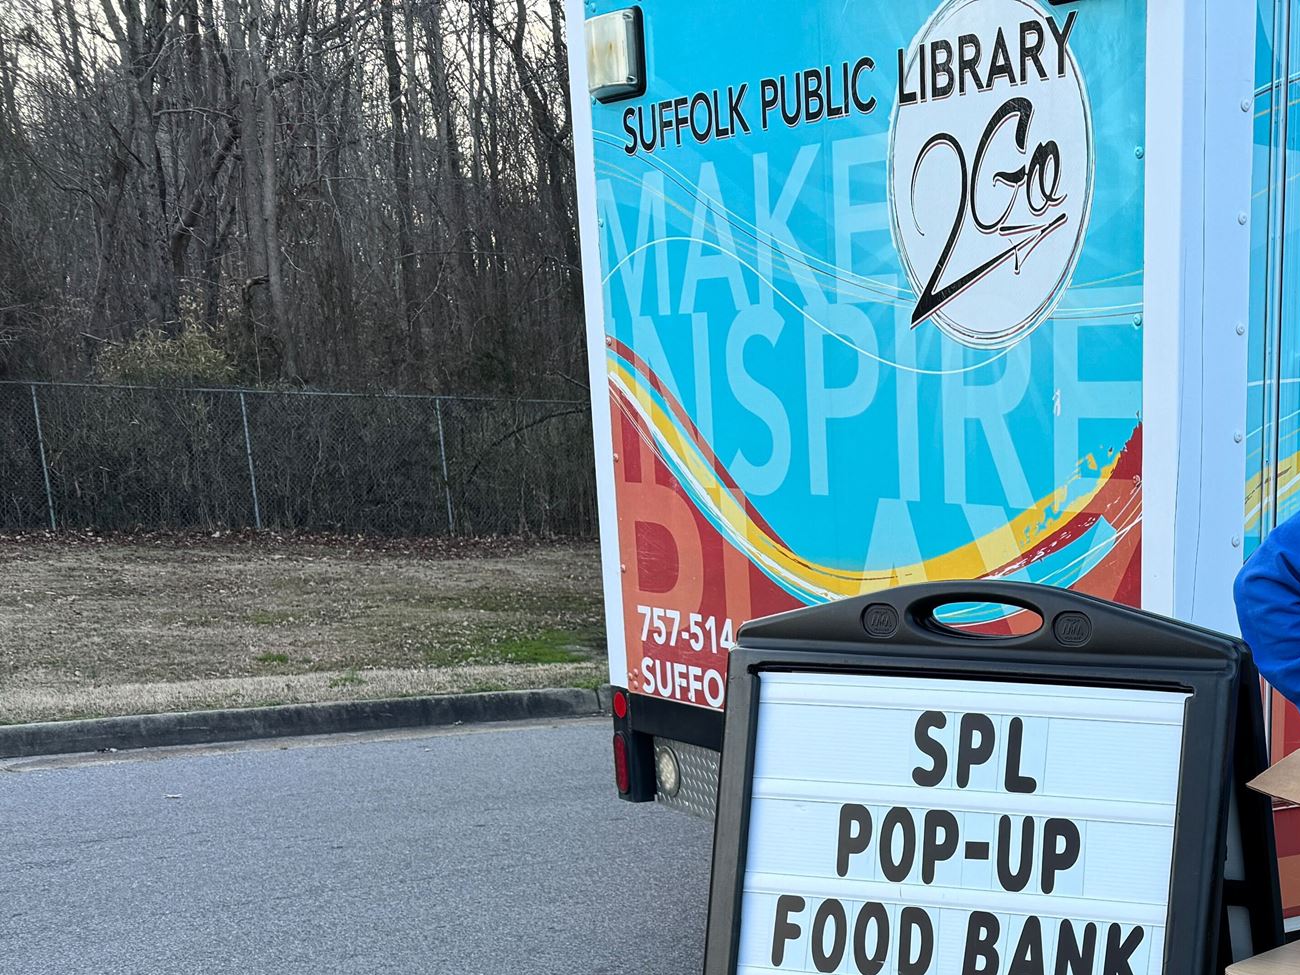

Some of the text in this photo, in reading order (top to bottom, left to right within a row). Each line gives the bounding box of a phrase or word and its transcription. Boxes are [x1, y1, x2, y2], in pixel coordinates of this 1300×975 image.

[622, 10, 1079, 157] SUFFOLK PUBLIC LIBRARY
[596, 132, 900, 316] MAKE
[636, 604, 738, 655] 757-514
[641, 656, 727, 708] SUFFO
[911, 710, 1038, 795] SPL
[836, 802, 1082, 895] POP-UP
